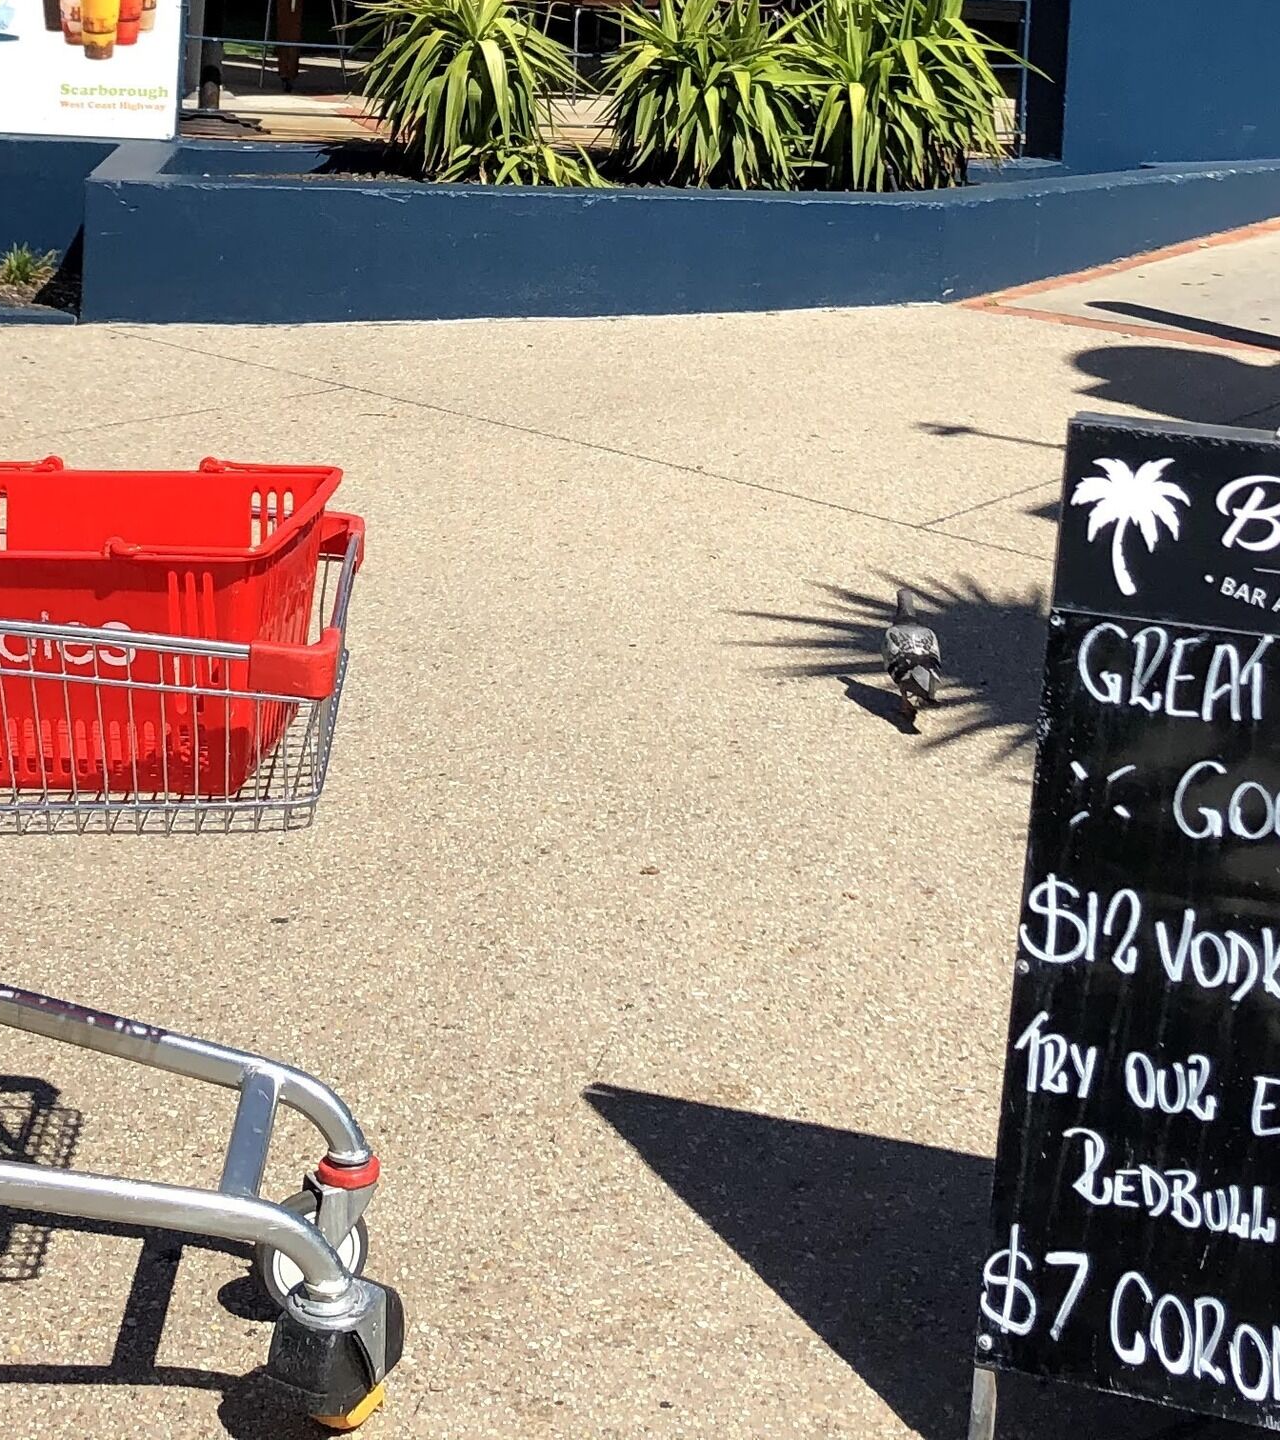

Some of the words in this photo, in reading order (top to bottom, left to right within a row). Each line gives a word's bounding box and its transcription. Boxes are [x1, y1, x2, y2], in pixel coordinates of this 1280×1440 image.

[59, 82, 169, 101] Scarborough
[59, 99, 85, 110] West
[87, 100, 117, 111] Coast
[119, 100, 166, 113] Highway
[1220, 576, 1267, 610] BAR
[1077, 622, 1274, 722] GREAT
[1019, 872, 1142, 974] $12
[1014, 1010, 1097, 1098] TRY
[1125, 1050, 1217, 1121] OUR
[1062, 1126, 1276, 1243] REDBULL
[979, 1222, 1090, 1340] $7
